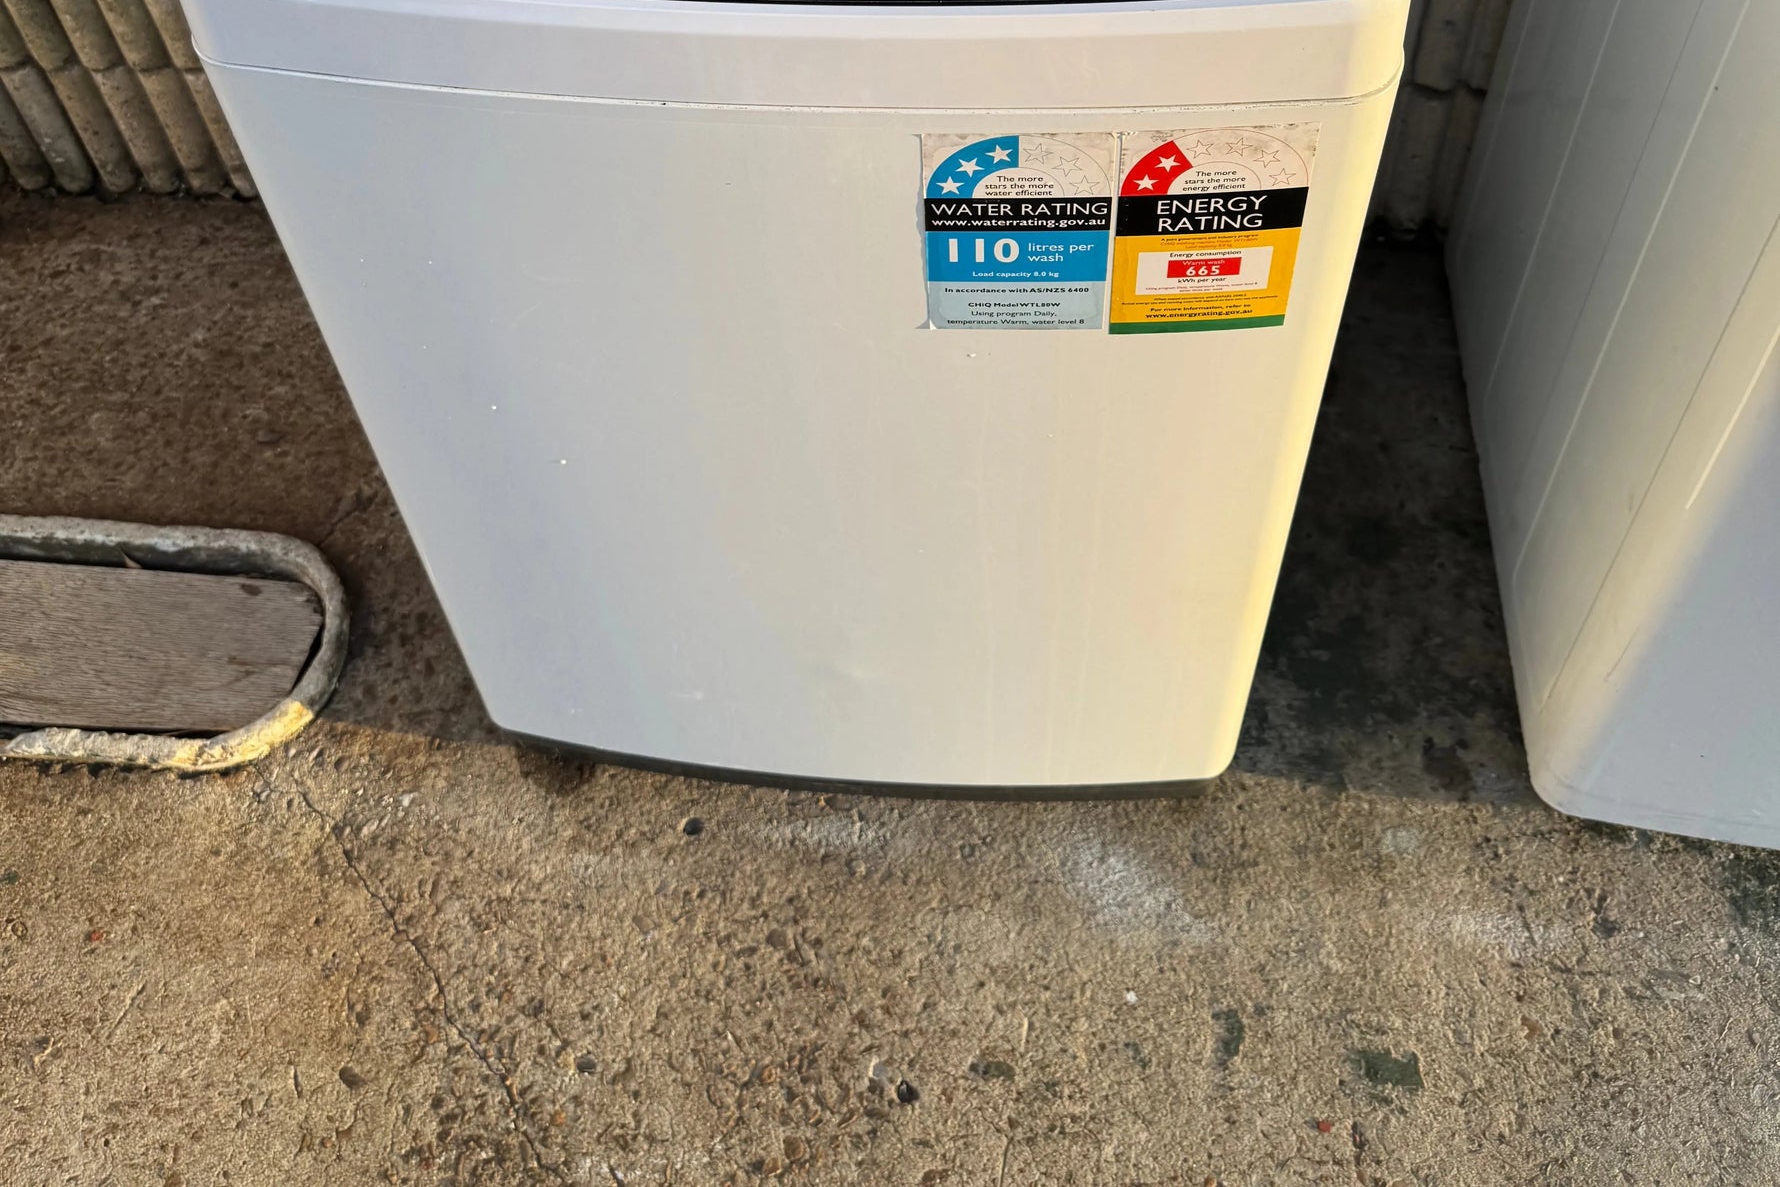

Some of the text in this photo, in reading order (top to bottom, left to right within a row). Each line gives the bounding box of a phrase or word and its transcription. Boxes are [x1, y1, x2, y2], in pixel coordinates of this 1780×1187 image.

[1182, 184, 1210, 192] energy
[931, 202, 1108, 216] WATER RATING
[1156, 195, 1267, 215] ENERGY
[932, 218, 1106, 228] www.waterrating.gov.au
[1158, 214, 1263, 233] RATING
[948, 238, 1020, 263] 110
[1028, 242, 1094, 253] litres per
[1028, 253, 1064, 262] wash
[1186, 266, 1220, 276] 665
[1145, 309, 1253, 318] www.energyrating.gov.au
